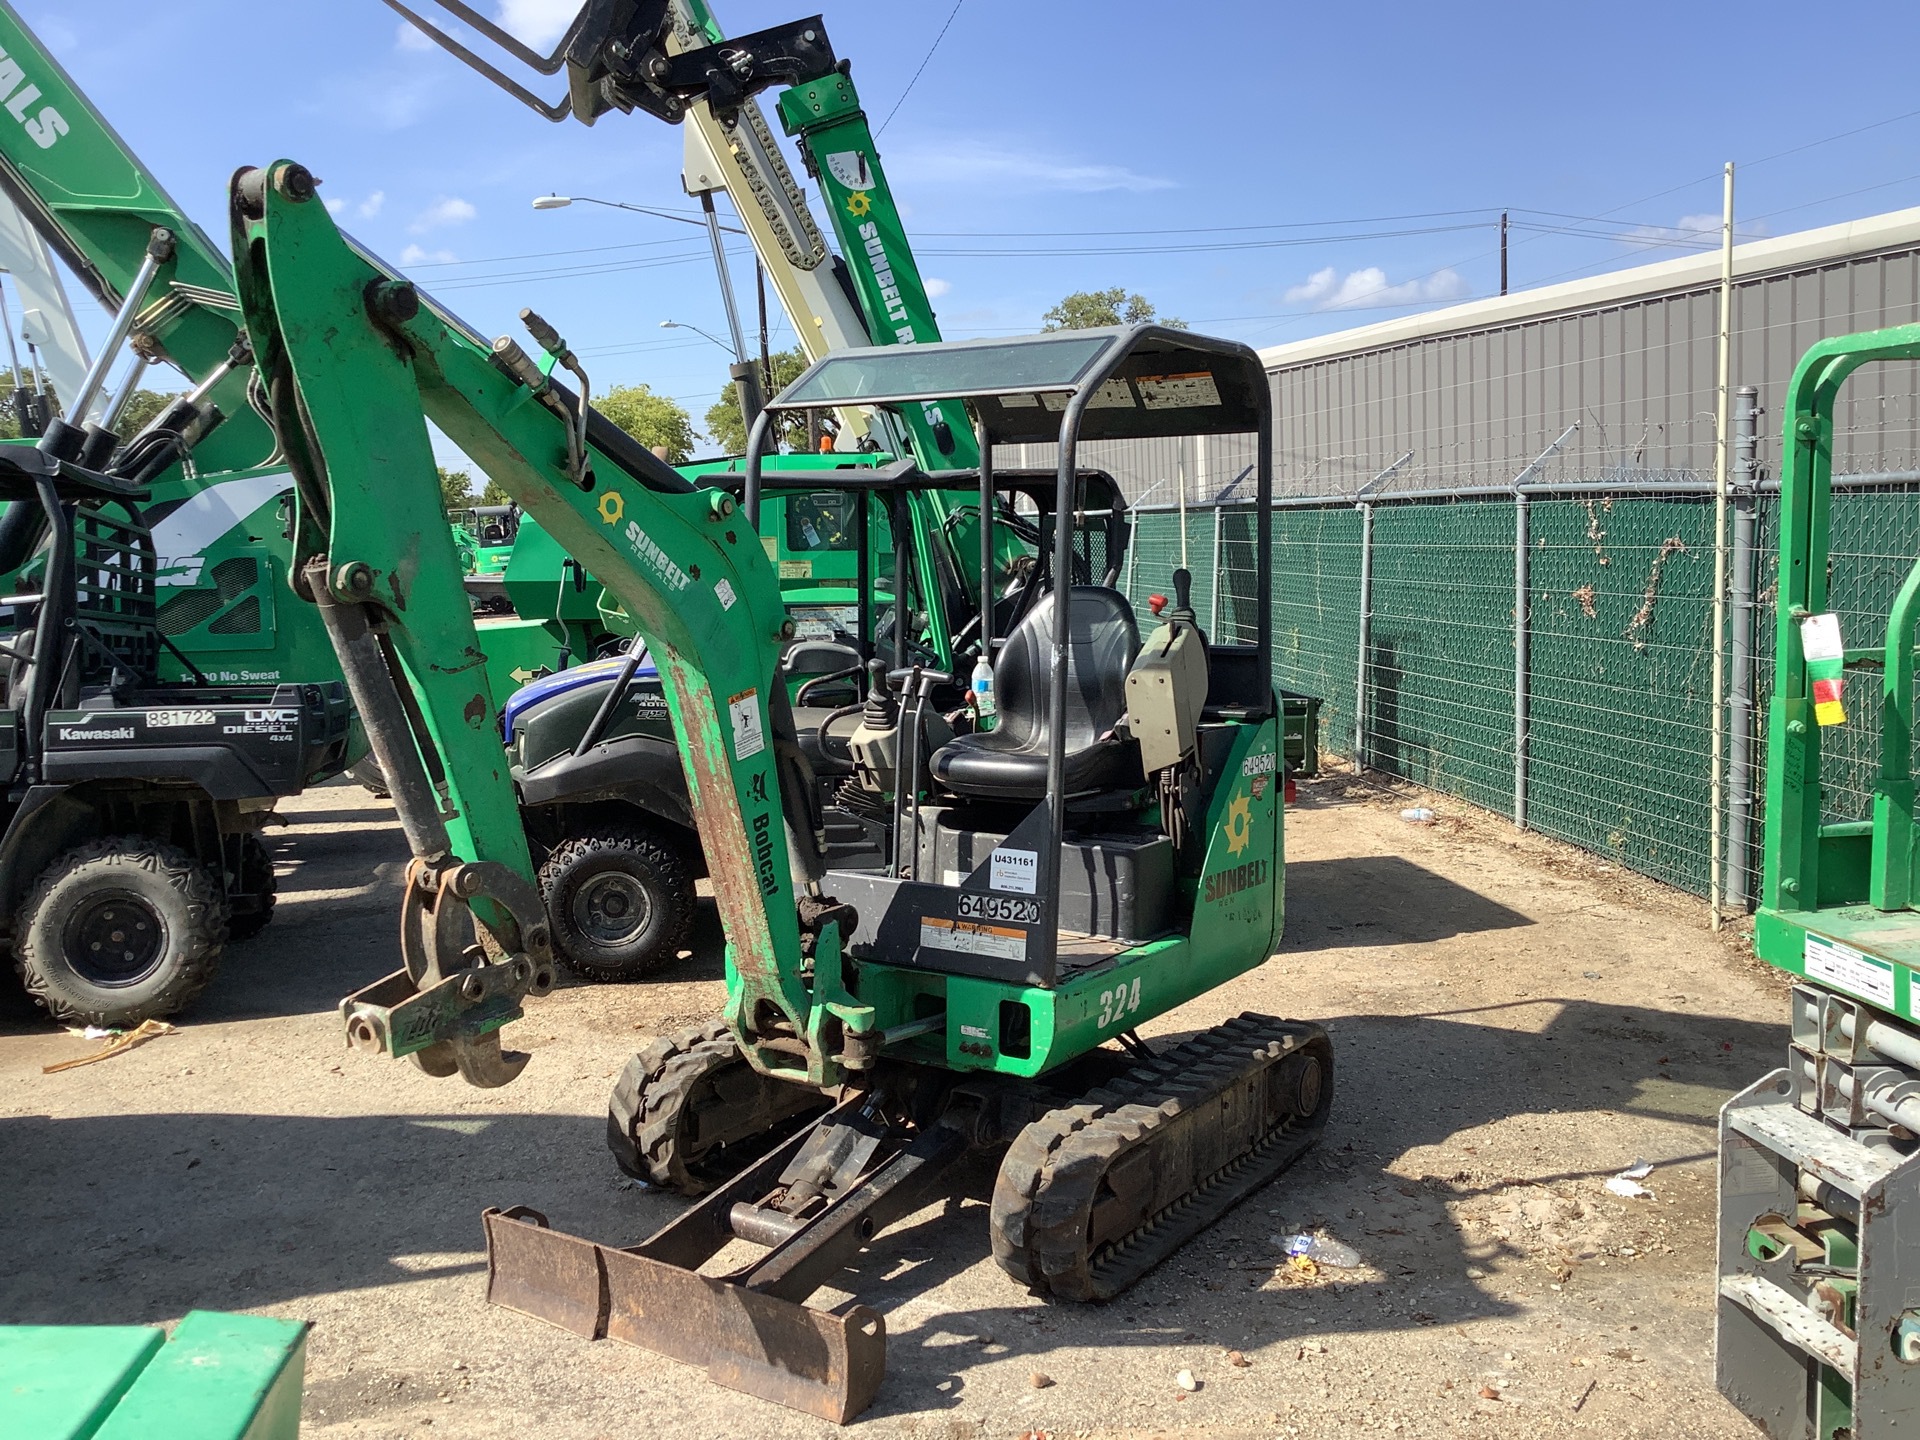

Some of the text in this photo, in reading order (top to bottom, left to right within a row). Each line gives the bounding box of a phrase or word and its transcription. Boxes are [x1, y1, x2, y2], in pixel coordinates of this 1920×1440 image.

[0, 46, 70, 149] ALS
[858, 221, 908, 322] SUNBELT
[620, 544, 676, 591] RENTALS
[625, 520, 691, 591] SUNBELT
[220, 671, 238, 681] No
[241, 670, 280, 680] Sweat
[149, 710, 215, 726] 881722
[223, 725, 294, 734] DIESEL
[59, 727, 135, 740] Kawasaki
[1244, 753, 1275, 776] 649520
[752, 812, 779, 896] Bobcat
[994, 855, 1034, 867] U431161
[1204, 859, 1269, 903] SUNBELT
[959, 895, 1040, 923] 649520
[961, 922, 993, 933] WARNING
[1098, 977, 1141, 1028] 324
